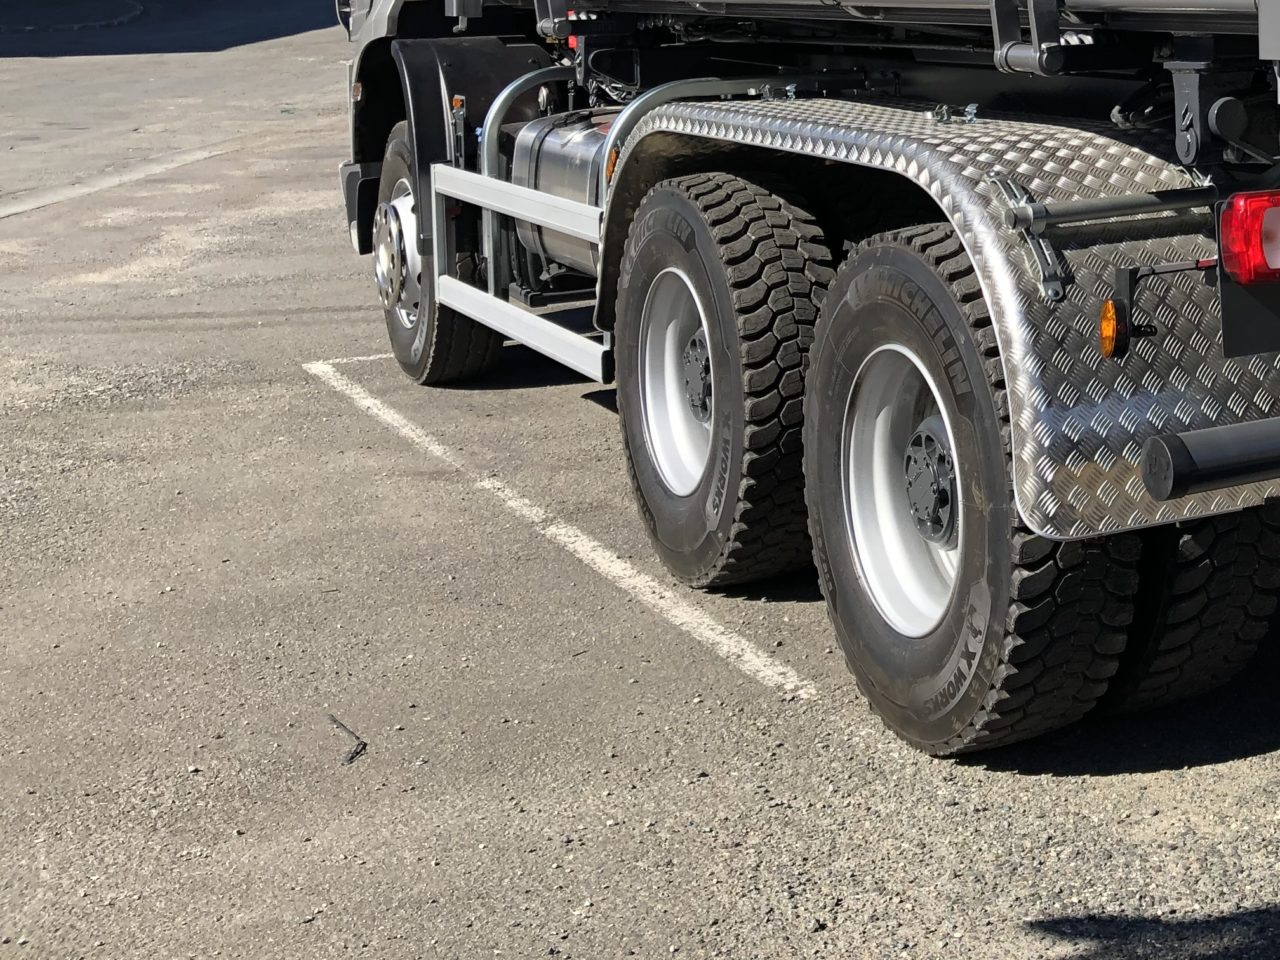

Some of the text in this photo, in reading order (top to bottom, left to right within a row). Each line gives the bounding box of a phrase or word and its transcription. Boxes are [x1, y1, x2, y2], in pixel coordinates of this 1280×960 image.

[876, 269, 973, 396] MICHELIN
[712, 436, 731, 516] WORKS
[922, 639, 977, 715] X WORKS
